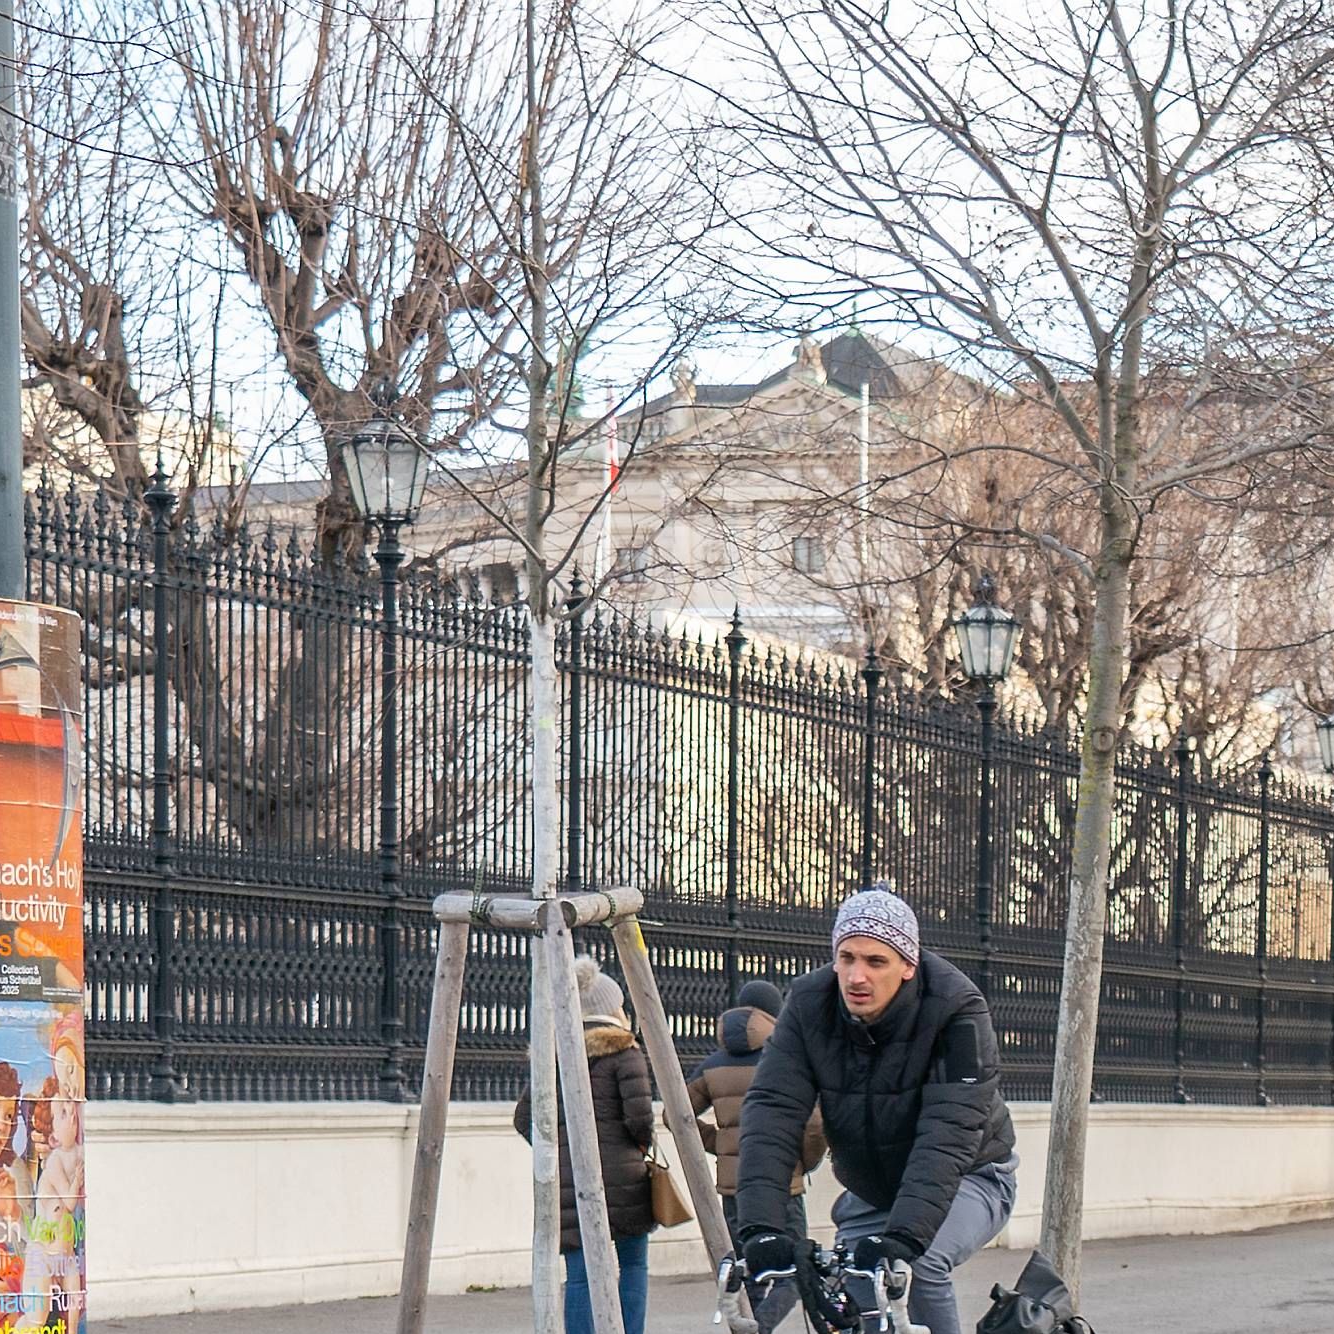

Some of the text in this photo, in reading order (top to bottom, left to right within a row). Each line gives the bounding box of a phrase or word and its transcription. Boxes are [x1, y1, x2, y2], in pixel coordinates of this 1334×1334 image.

[56, 858, 81, 897] Holy
[1, 964, 33, 974] Collection
[23, 1214, 58, 1241] Van
